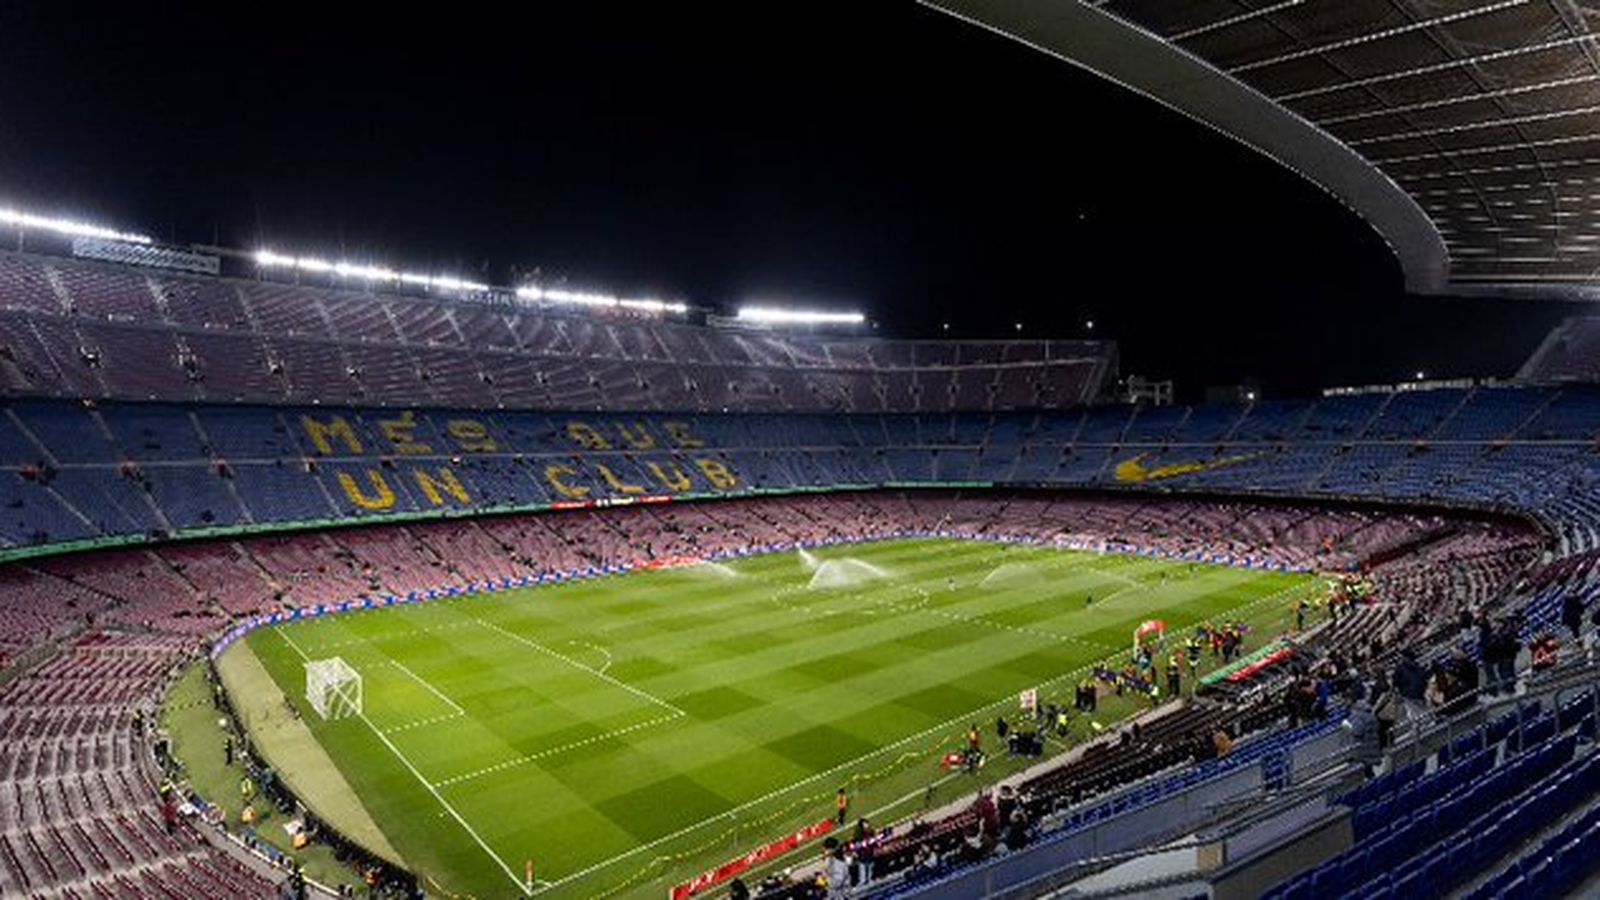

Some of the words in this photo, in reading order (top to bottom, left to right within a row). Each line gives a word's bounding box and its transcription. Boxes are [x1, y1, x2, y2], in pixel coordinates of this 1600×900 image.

[566, 421, 706, 450] QUE
[337, 466, 471, 511] UN
[545, 458, 741, 498] CLUB
